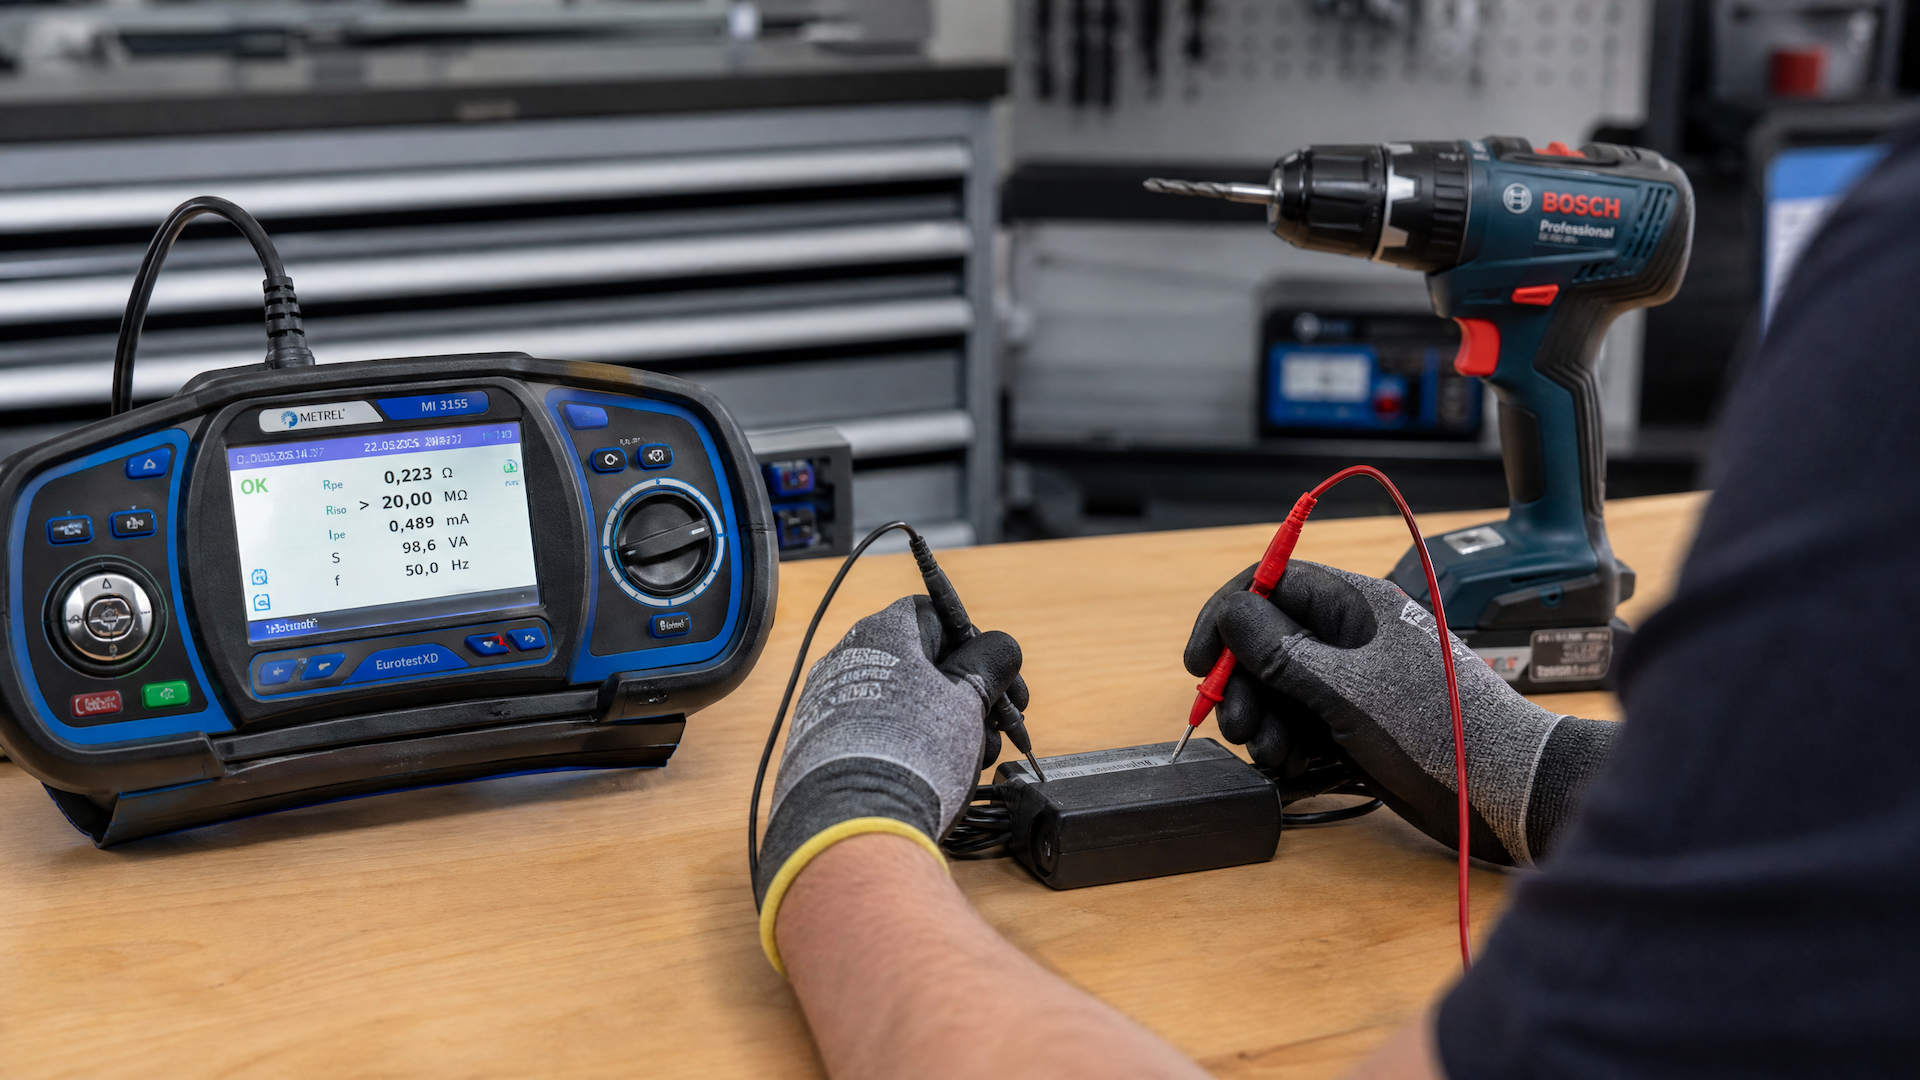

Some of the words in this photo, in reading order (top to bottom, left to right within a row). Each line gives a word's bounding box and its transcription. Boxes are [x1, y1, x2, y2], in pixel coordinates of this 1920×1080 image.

[1542, 191, 1620, 219] BOSCH
[1540, 218, 1615, 239] Professional
[421, 401, 436, 412] MI
[440, 398, 468, 411] 3155
[300, 410, 344, 423] METREL
[240, 477, 269, 494] OK
[322, 479, 343, 492] Rpe
[384, 467, 432, 486] 0,223
[442, 467, 453, 478] Ω
[325, 505, 347, 515] Riso
[382, 491, 432, 510] 20,00
[444, 490, 468, 502] MΩ
[389, 516, 434, 534] 0,489
[446, 513, 470, 526] mA
[331, 552, 341, 564] S
[402, 539, 436, 554] 98,6
[448, 535, 469, 548] VA
[334, 574, 340, 586] f
[405, 562, 439, 576] 50,0
[451, 559, 470, 571] Hz
[376, 652, 439, 670] EurotestXD
